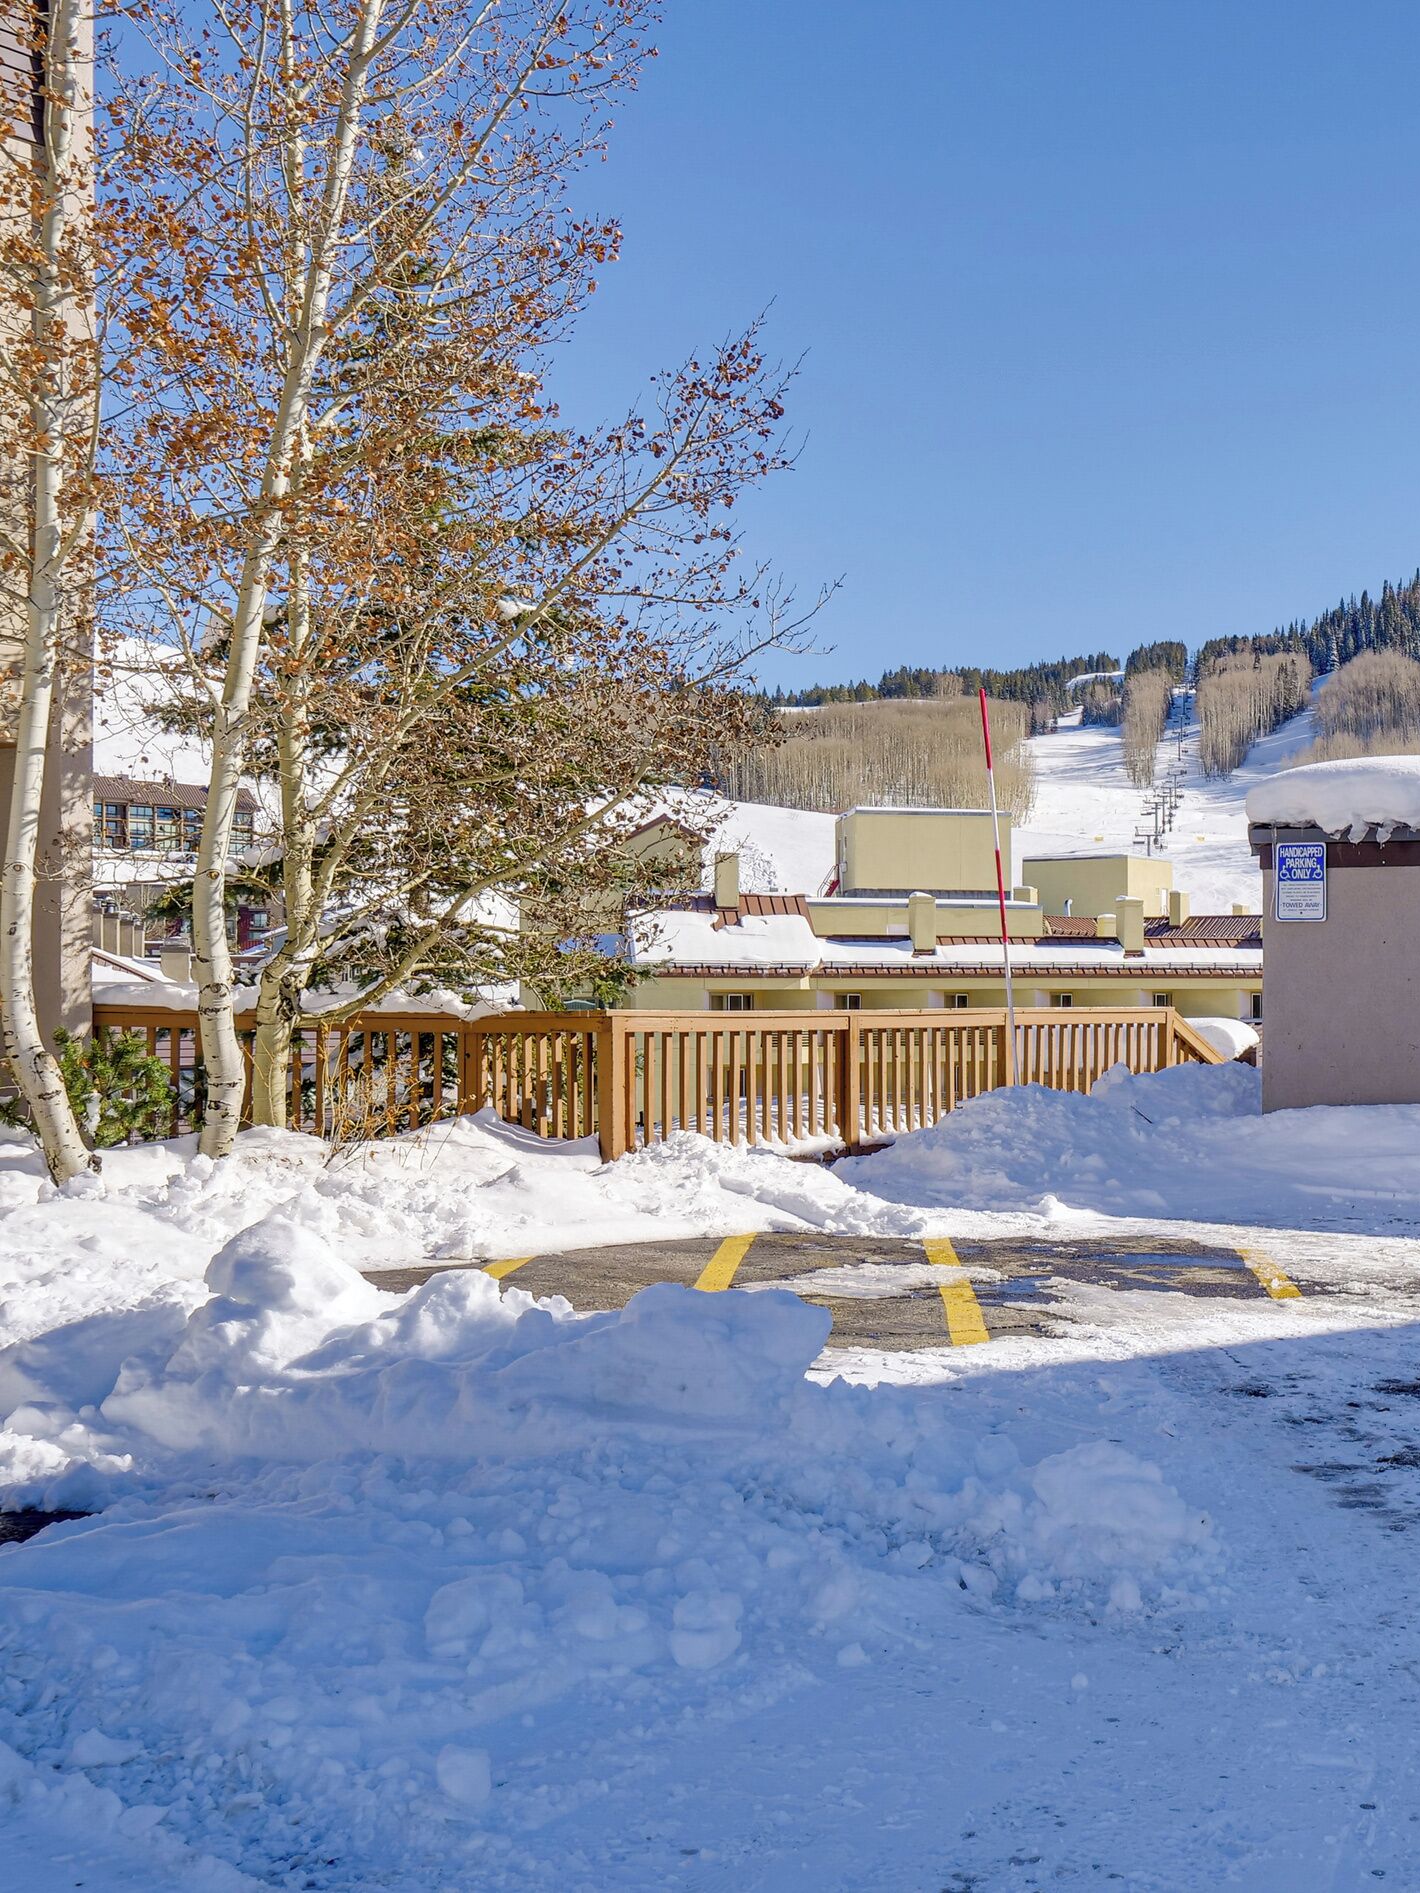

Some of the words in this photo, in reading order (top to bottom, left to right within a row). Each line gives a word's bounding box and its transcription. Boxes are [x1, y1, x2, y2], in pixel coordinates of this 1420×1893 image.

[1280, 846, 1323, 857] HANDICAPPED
[1285, 858, 1317, 868] PARKING
[1291, 868, 1312, 879] ONLY
